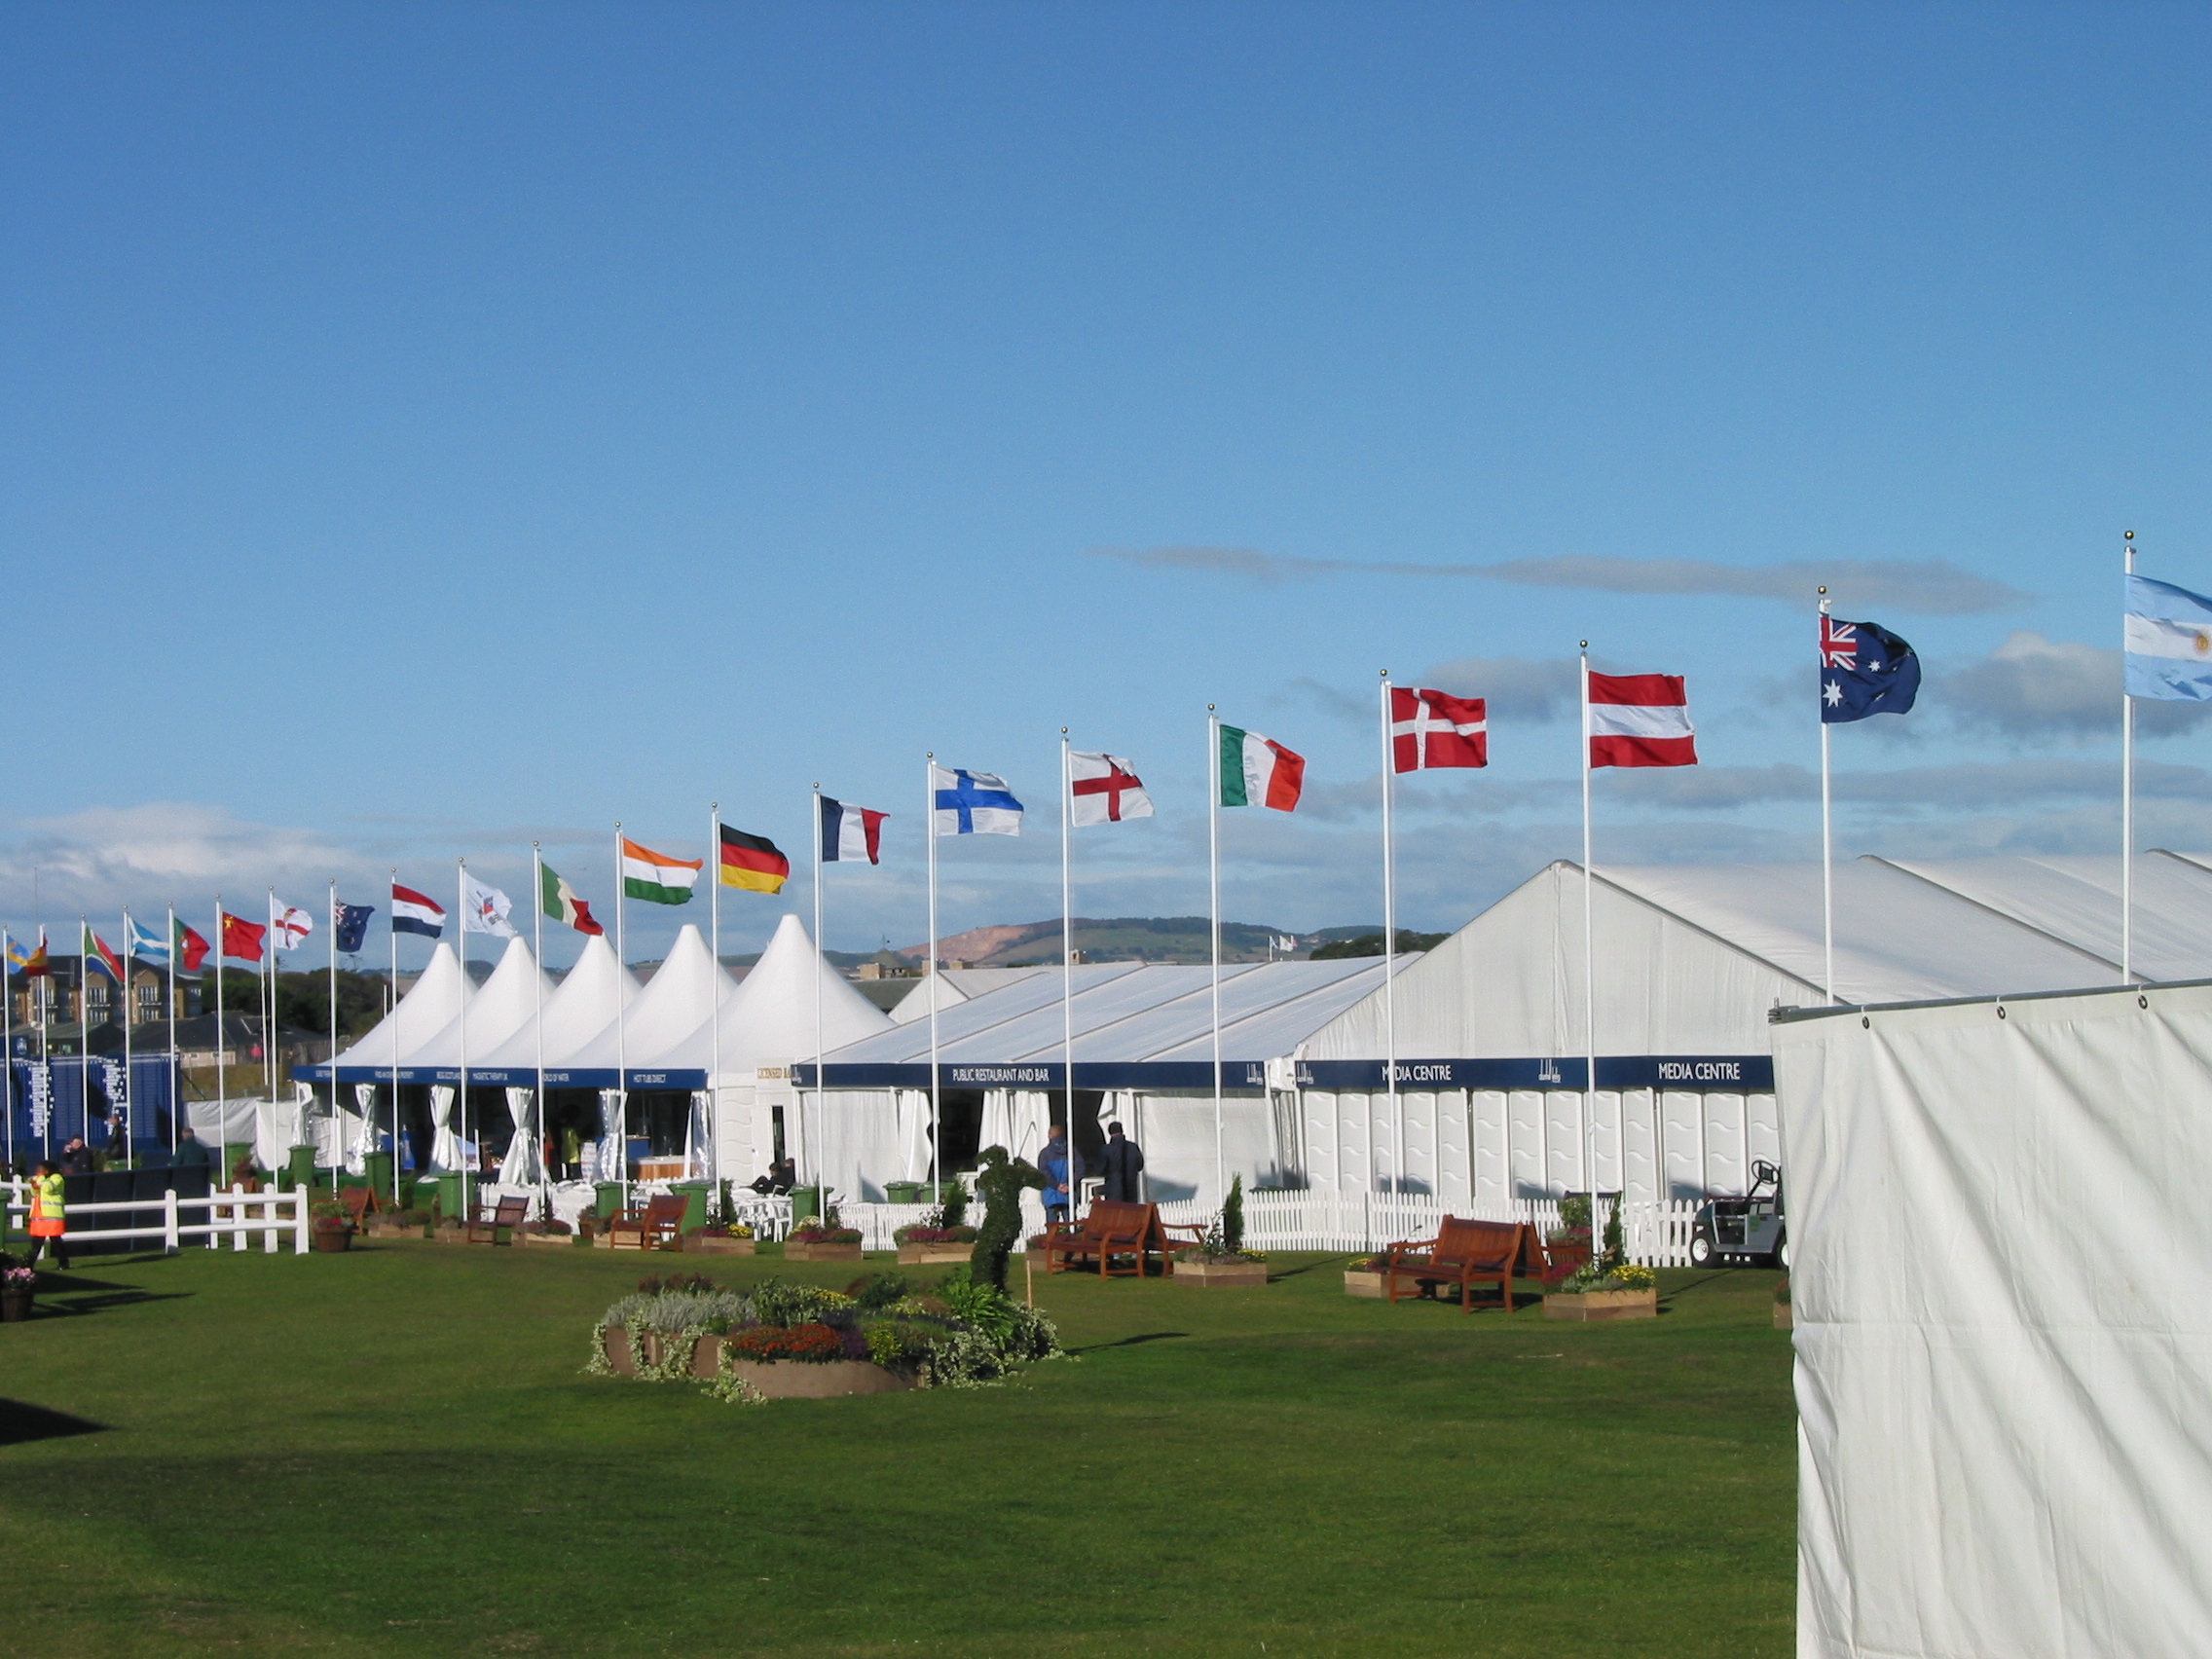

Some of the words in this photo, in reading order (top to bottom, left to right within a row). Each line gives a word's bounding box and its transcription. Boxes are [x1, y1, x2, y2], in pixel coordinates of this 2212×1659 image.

[952, 1068, 975, 1082] PUBLIC
[975, 1068, 1017, 1082] RESTAURANT
[1017, 1068, 1033, 1082] AND
[1034, 1068, 1050, 1082] BAR
[1382, 1066, 1412, 1081] MDIA
[1414, 1065, 1452, 1081] CENTRE
[1658, 1063, 1694, 1080] MEDIA
[1695, 1063, 1741, 1081] CENTRE
